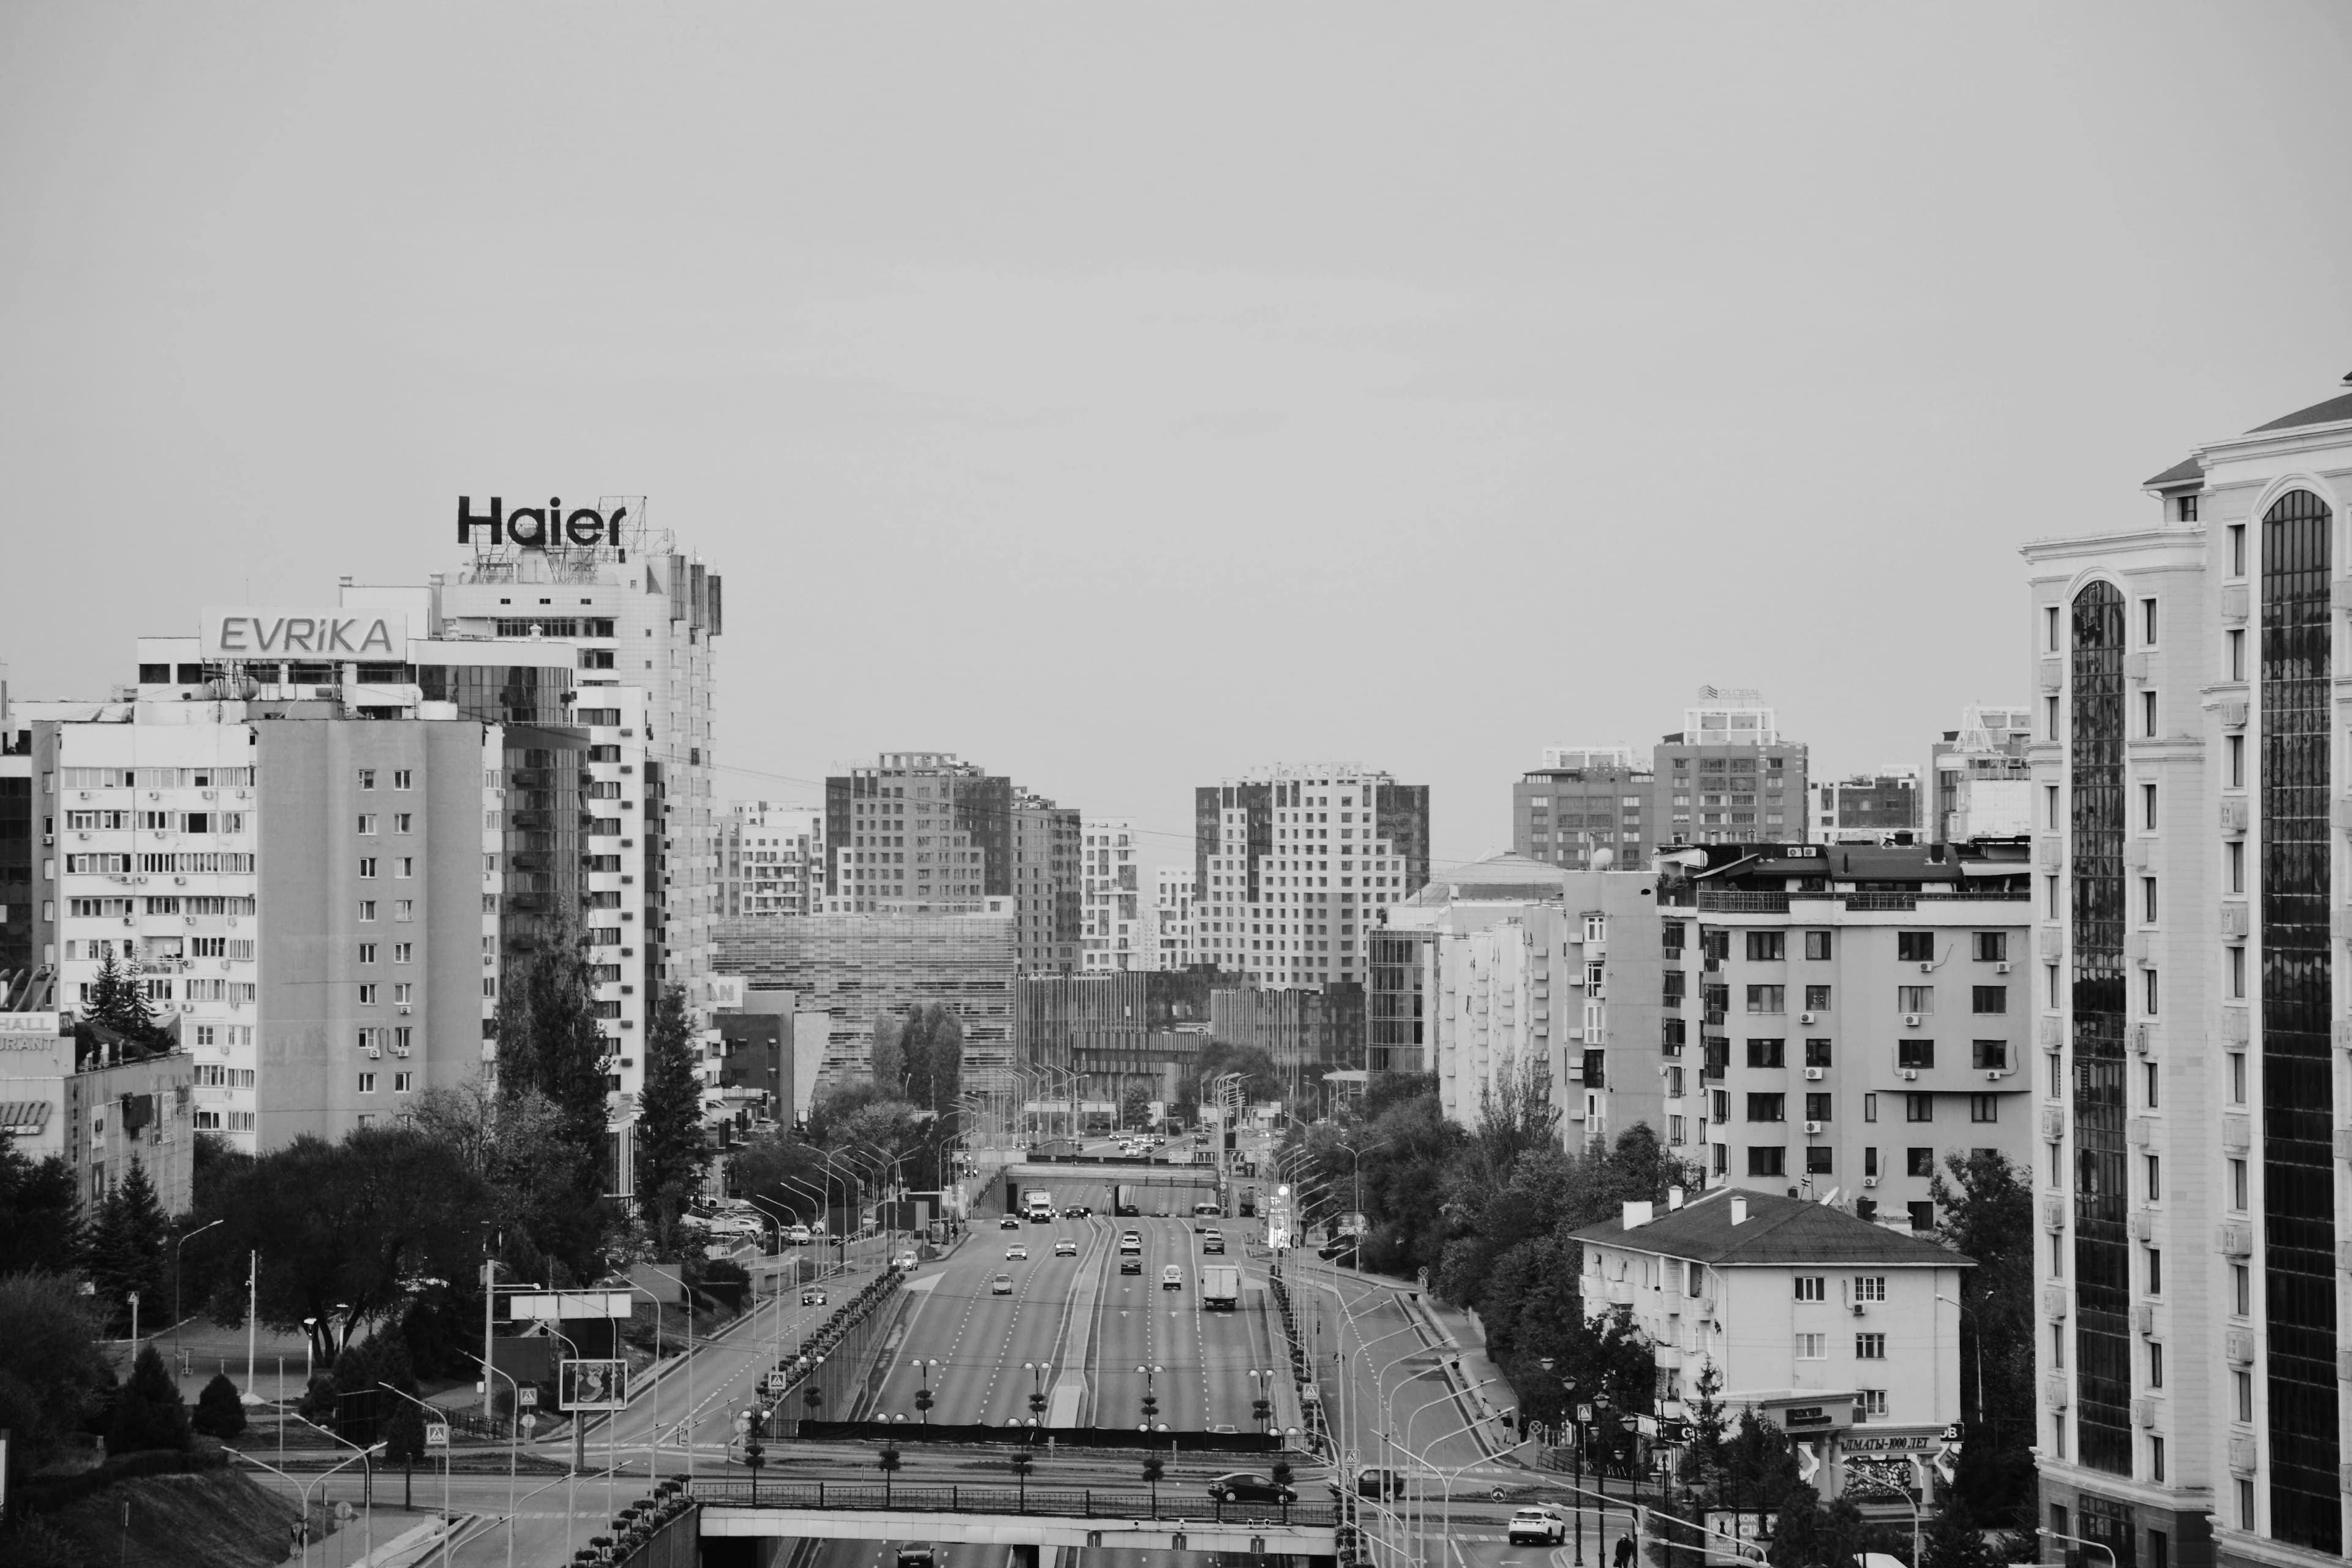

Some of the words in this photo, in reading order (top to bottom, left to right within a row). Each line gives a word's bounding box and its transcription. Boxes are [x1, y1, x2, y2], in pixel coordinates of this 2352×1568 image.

[458, 496, 627, 546] Haier
[1720, 688, 1762, 698] GLOBAL
[1908, 1437, 1929, 1449] ЛЕТ
